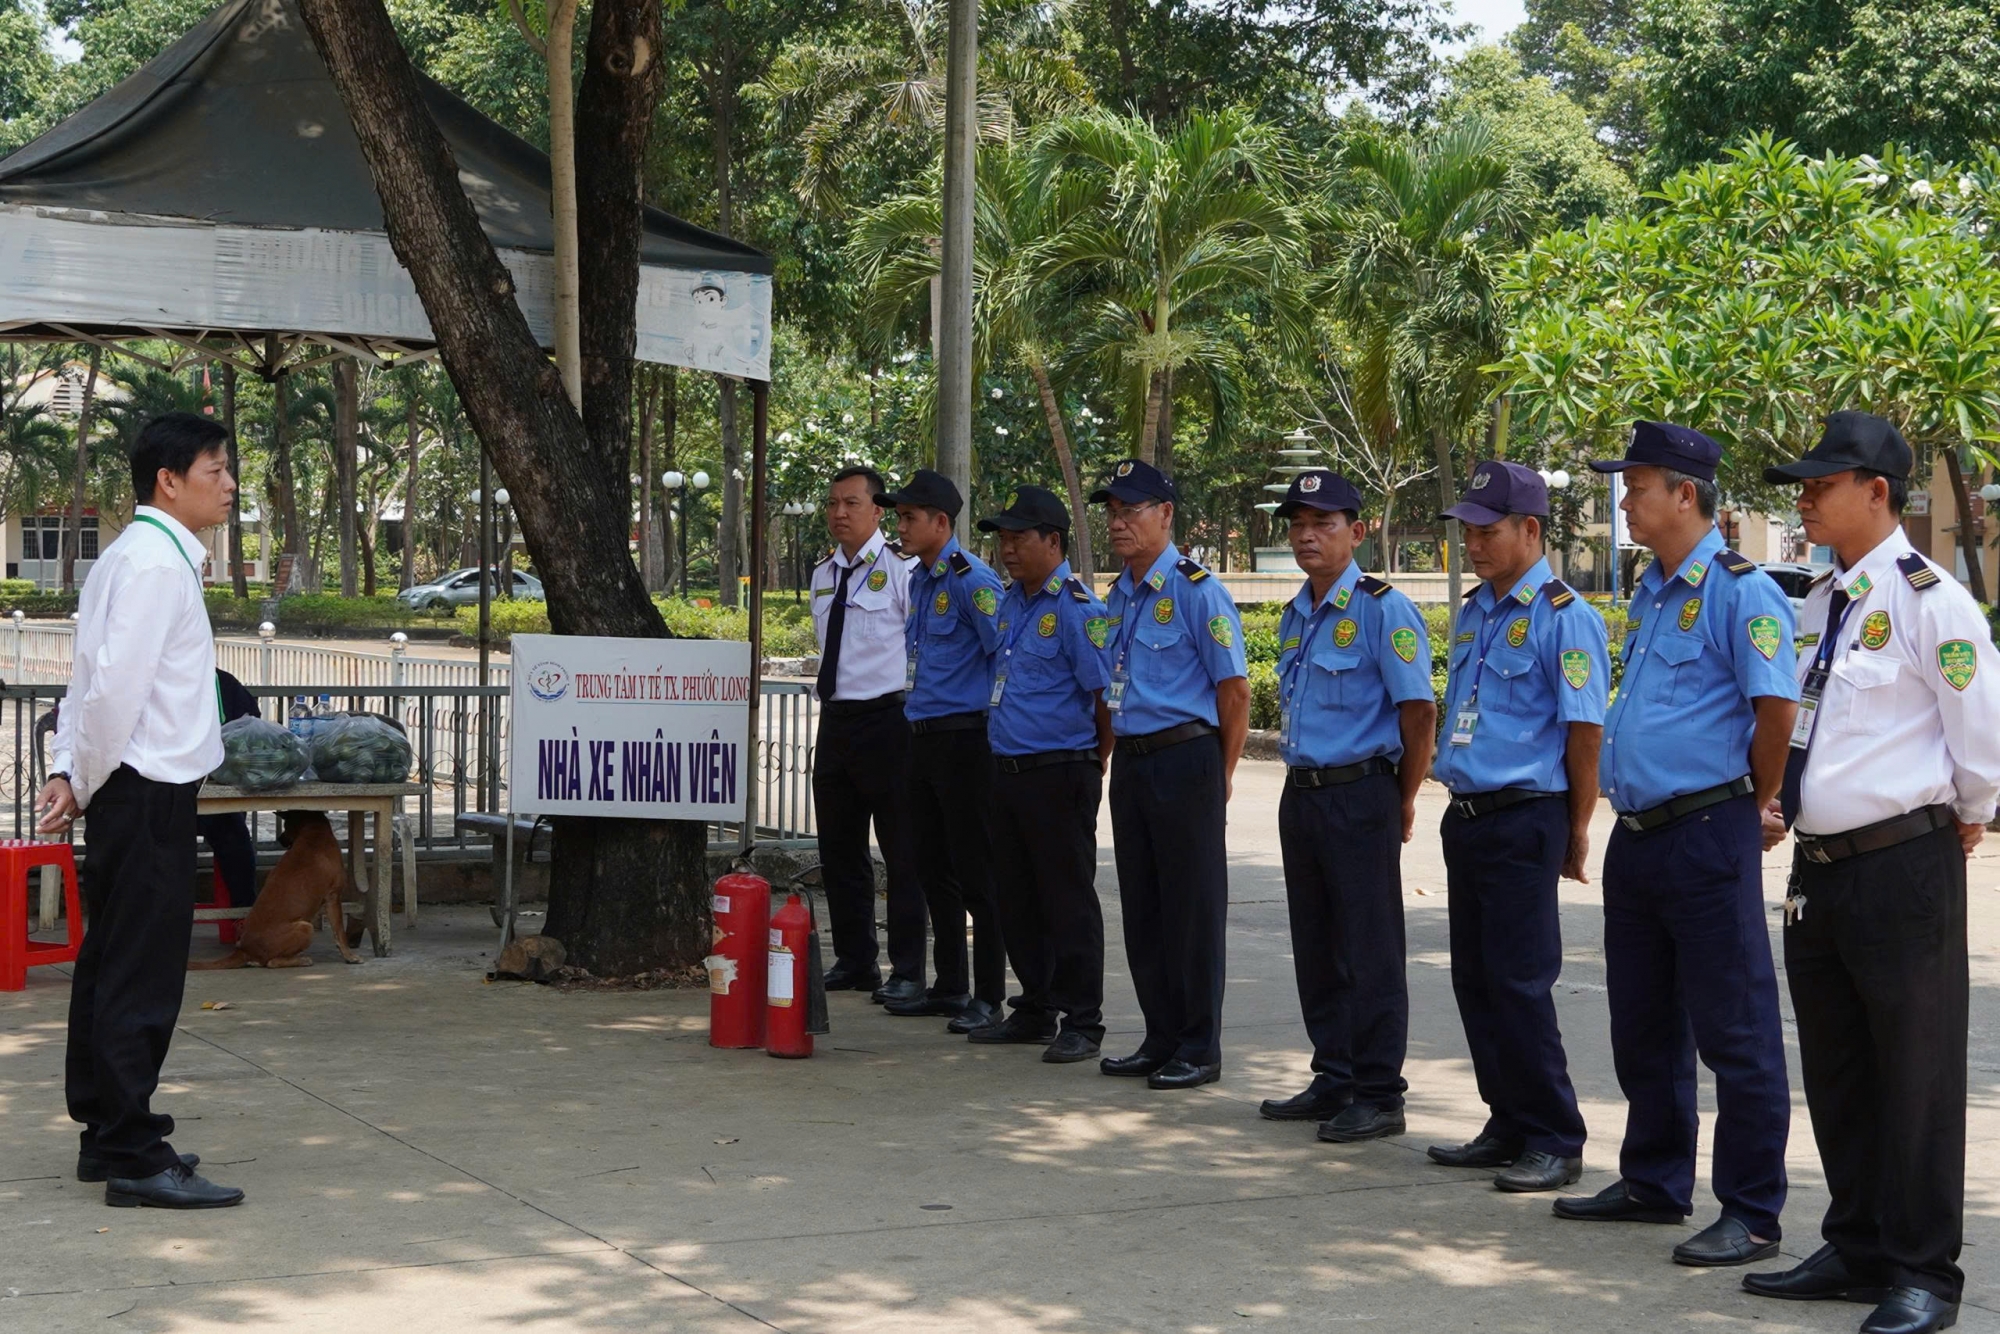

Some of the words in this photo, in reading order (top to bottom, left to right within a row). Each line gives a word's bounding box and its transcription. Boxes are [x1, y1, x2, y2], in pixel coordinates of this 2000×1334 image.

[575, 673, 612, 699] TRUNG
[614, 666, 636, 699] TÂM
[639, 675, 646, 699] Y
[648, 664, 663, 700] TẾ
[664, 675, 679, 700] TX.
[682, 668, 719, 701] PHƯỚC
[721, 676, 750, 701] LONG
[538, 726, 582, 800] NHÀ
[588, 740, 615, 801] XE
[622, 728, 682, 803] NHÂN
[688, 729, 737, 804] VIÊN
